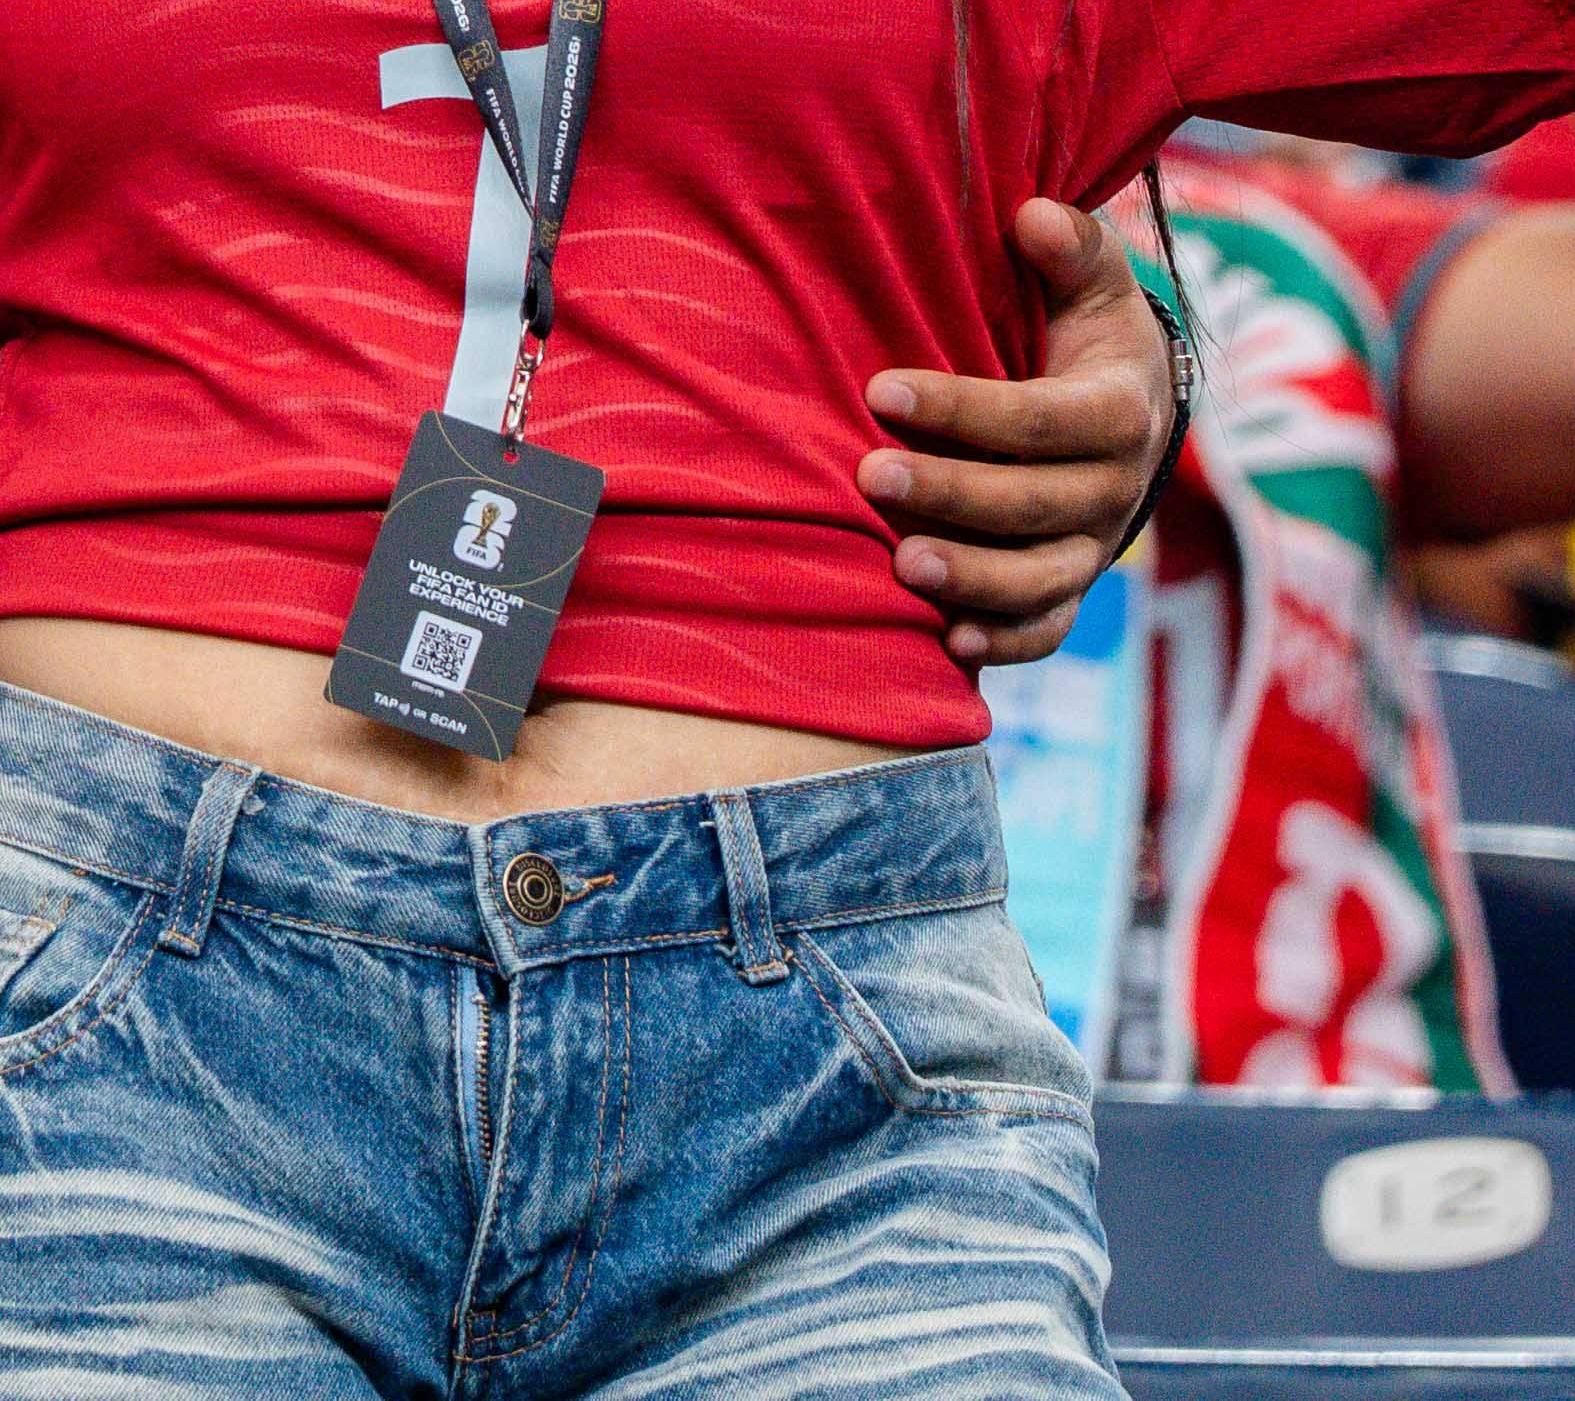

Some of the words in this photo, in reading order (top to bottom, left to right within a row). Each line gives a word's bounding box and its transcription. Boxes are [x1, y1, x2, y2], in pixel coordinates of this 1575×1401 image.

[486, 88, 501, 118] FIFA
[560, 90, 573, 119] CUP
[553, 120, 569, 170] WORLD
[549, 174, 560, 204] FIFA
[466, 547, 487, 560] FIFA
[409, 559, 476, 591] UNLOCK
[479, 583, 524, 609] YOUR
[416, 574, 452, 595] FIFA
[455, 587, 490, 608] FAN
[491, 599, 509, 614] ID
[409, 583, 509, 627] EXPERIENCE
[374, 691, 399, 708] TAP
[429, 712, 468, 734] SCAN
[1379, 1165, 1498, 1236] 12
